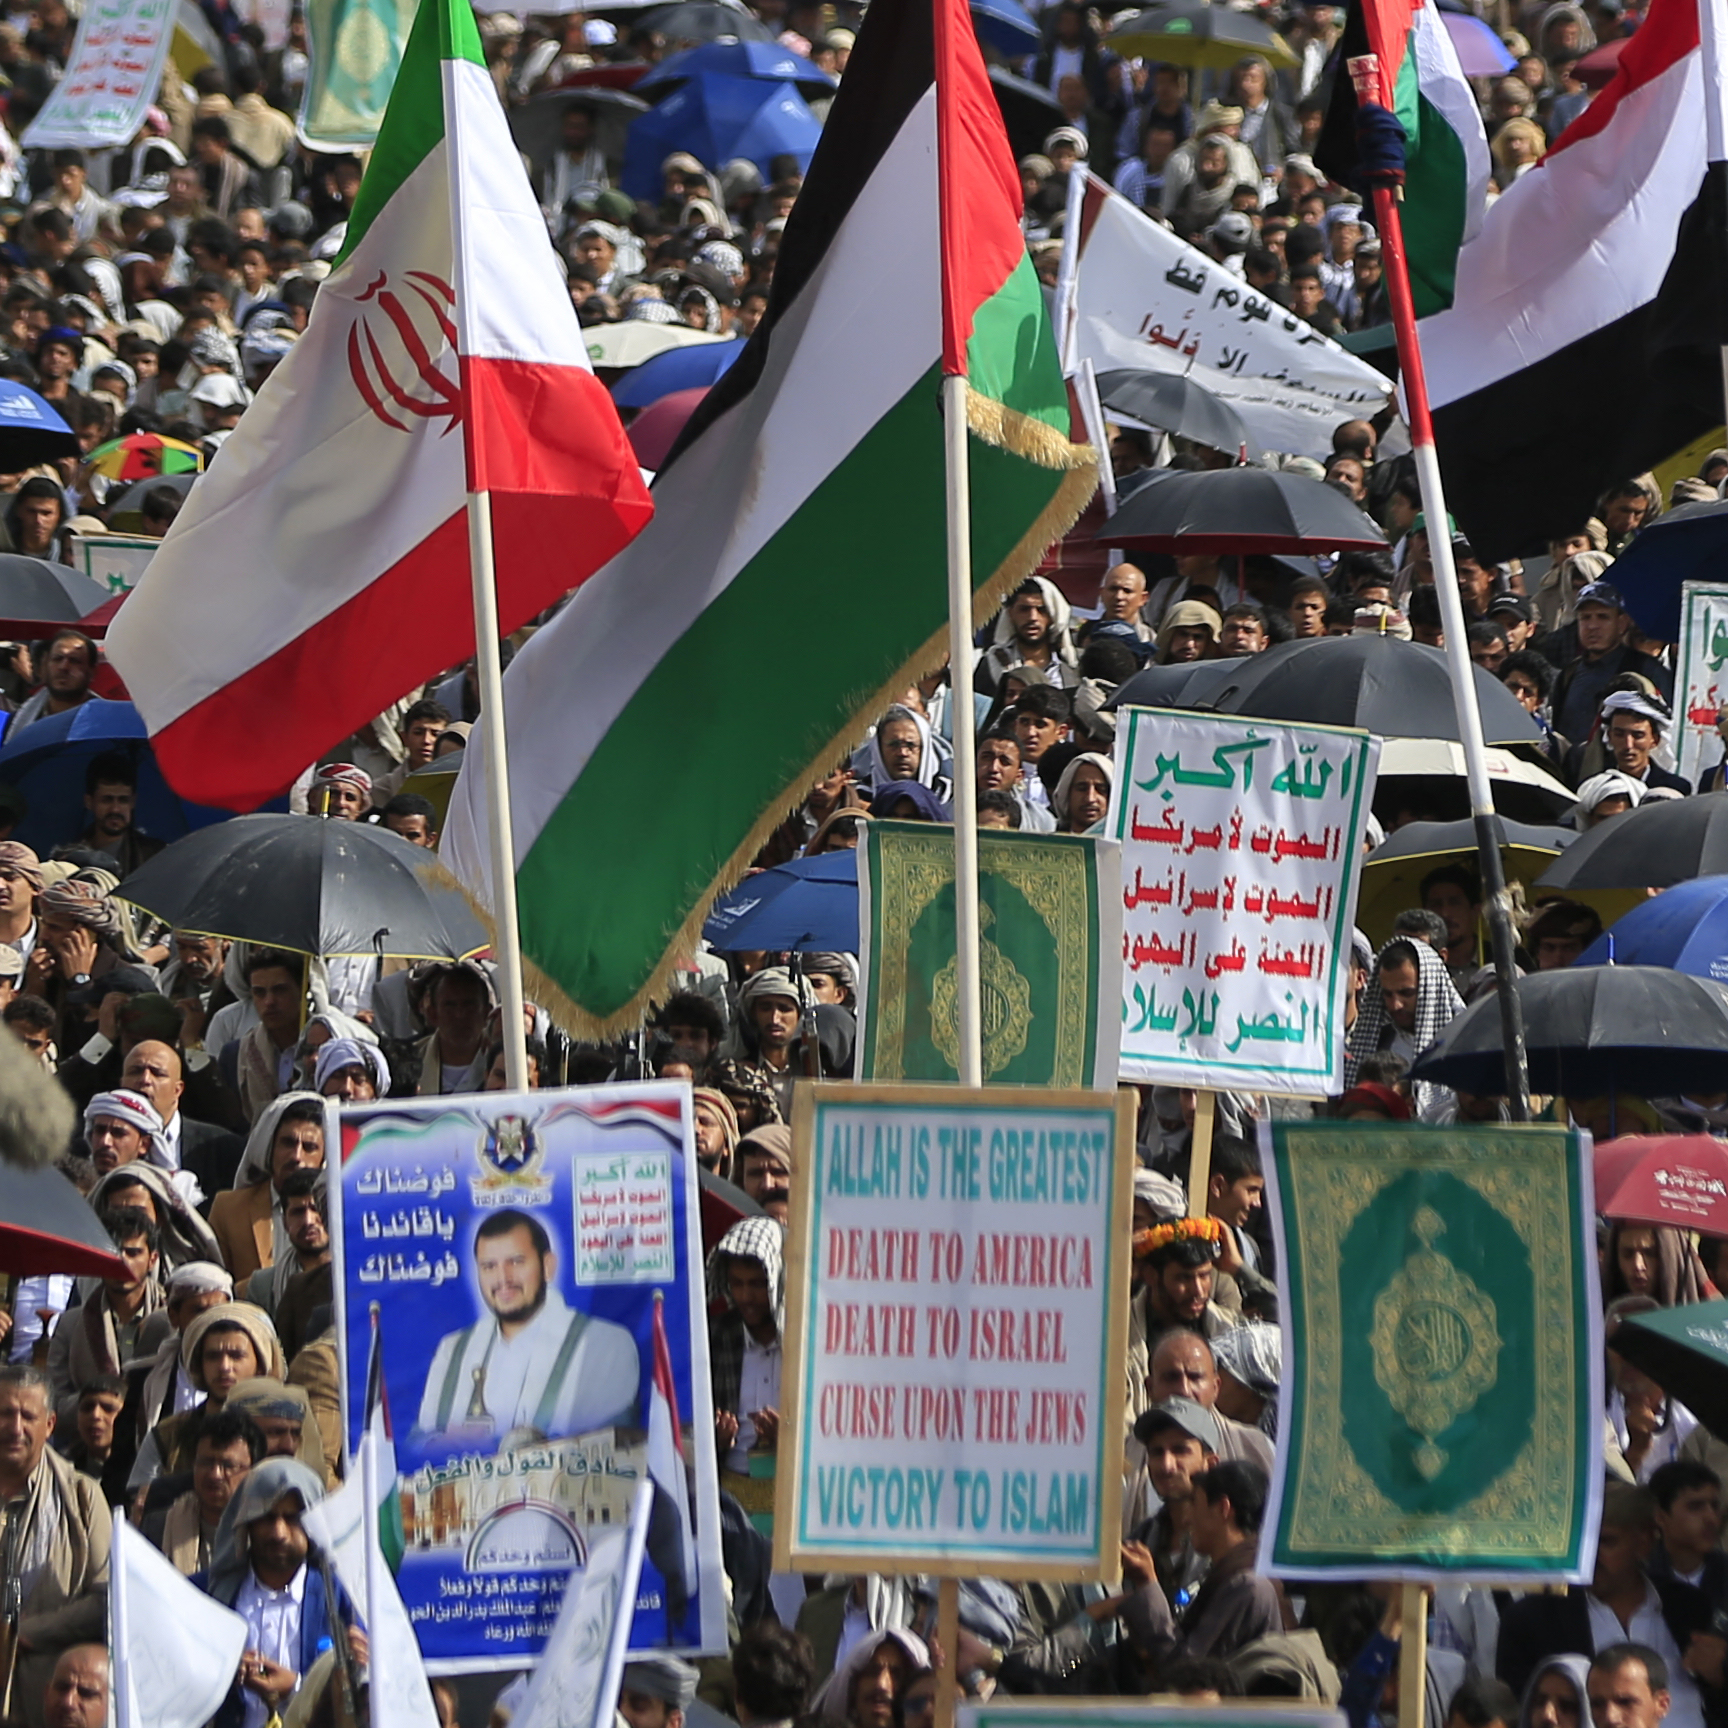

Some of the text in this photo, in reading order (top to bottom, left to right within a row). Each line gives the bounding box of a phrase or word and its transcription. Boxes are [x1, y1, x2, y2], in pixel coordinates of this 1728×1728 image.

[1134, 729, 1352, 802] الله أكبر
[1132, 804, 1341, 863] الموت لأمريكا
[1244, 882, 1333, 923] الموت
[1123, 929, 1324, 980] اللعنة على اليهود
[1224, 989, 1319, 1052] النصر
[635, 1160, 665, 1179] الله
[827, 1124, 1105, 1205] ALLAH IS THE GREATEST
[828, 1227, 1093, 1289] DEATH TO AMERICA
[825, 1302, 1067, 1363] DEATH TO ISRAEL
[820, 1383, 1086, 1446] CURSE UPON THE JEWS
[818, 1465, 1089, 1536] VICTORY TO ISLAM
